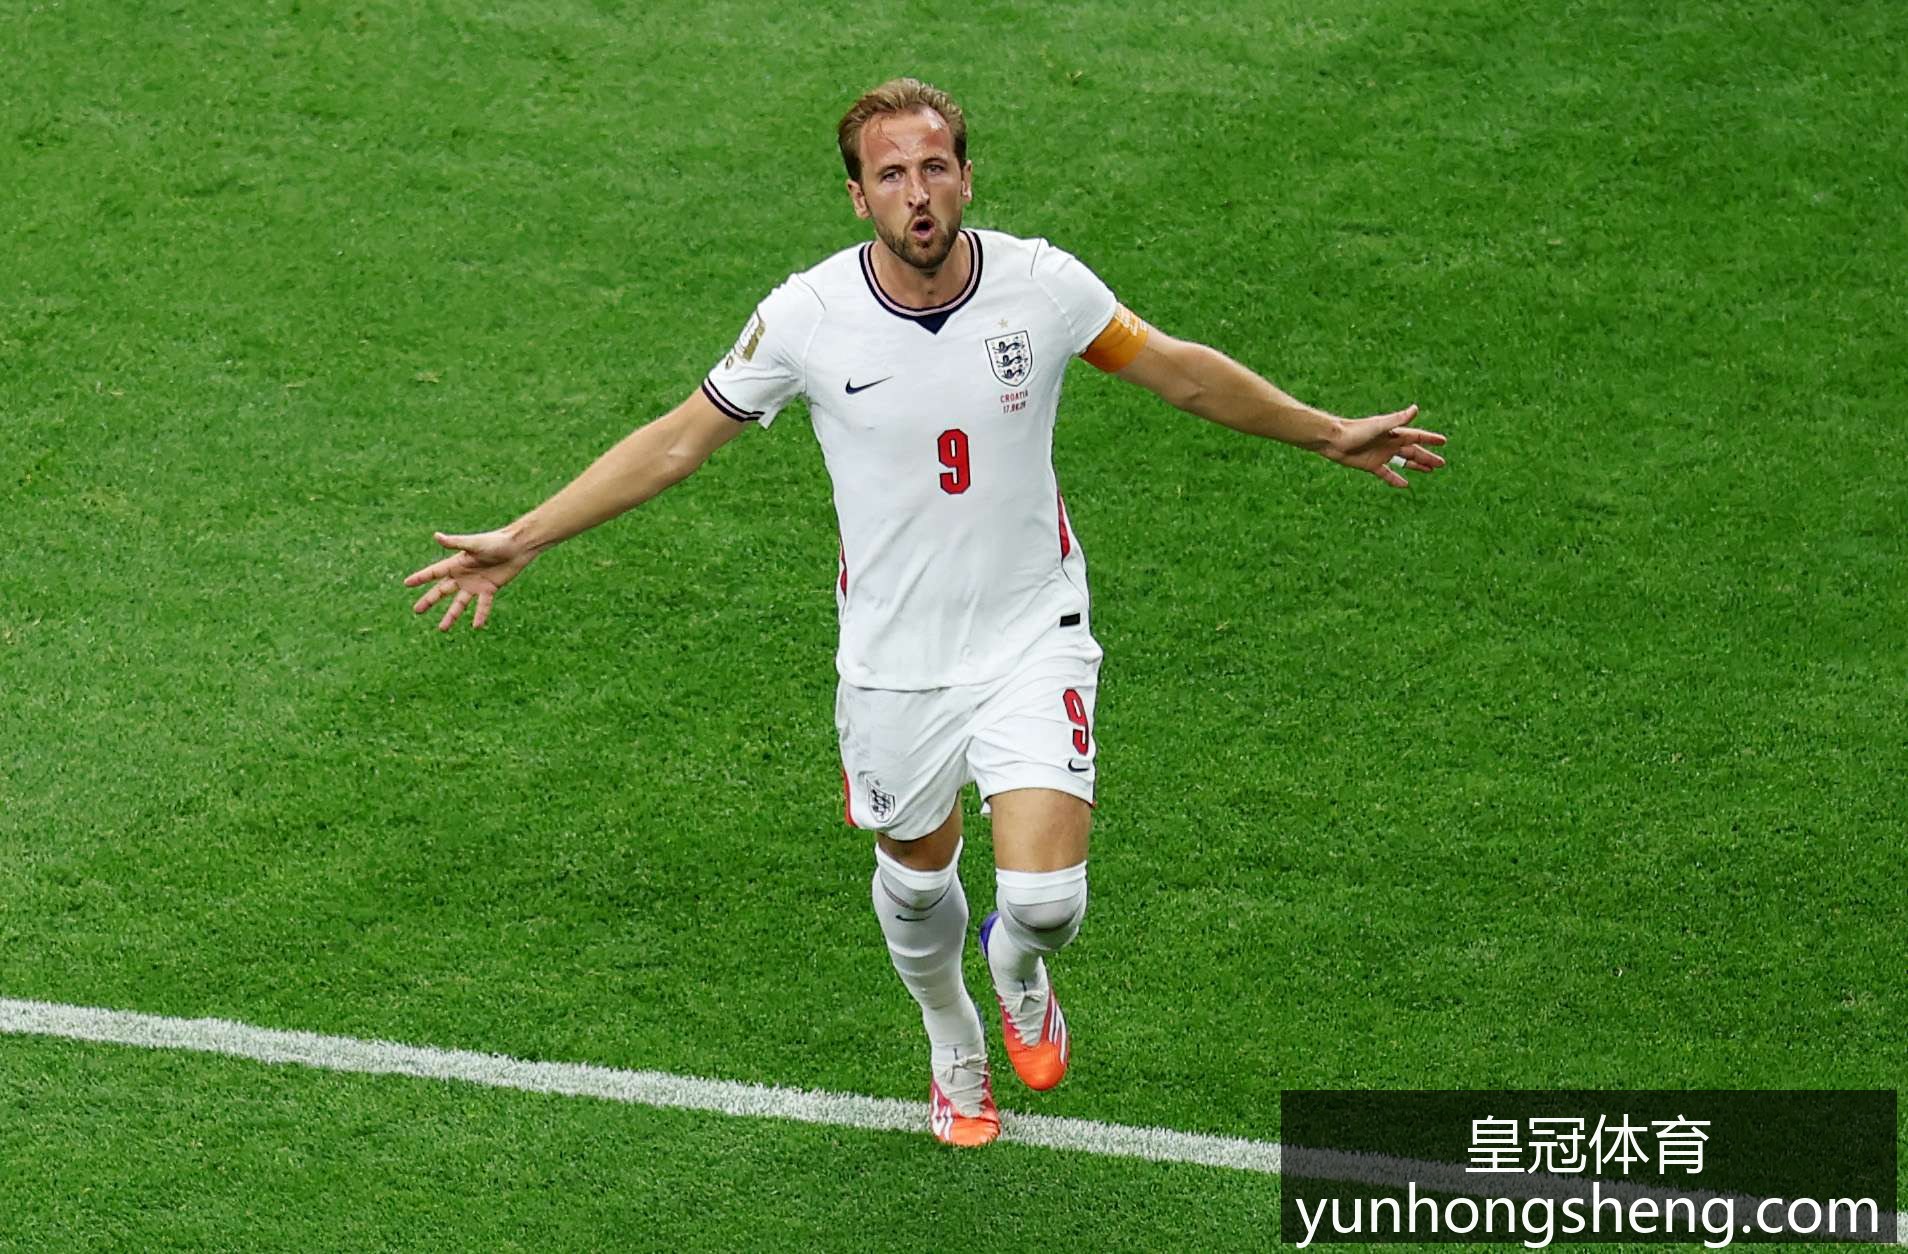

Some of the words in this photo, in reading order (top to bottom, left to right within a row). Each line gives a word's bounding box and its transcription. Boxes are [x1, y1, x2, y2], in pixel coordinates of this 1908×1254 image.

[1000, 390, 1028, 403] CROATIA
[937, 428, 971, 495] 9
[1063, 688, 1090, 756] 9
